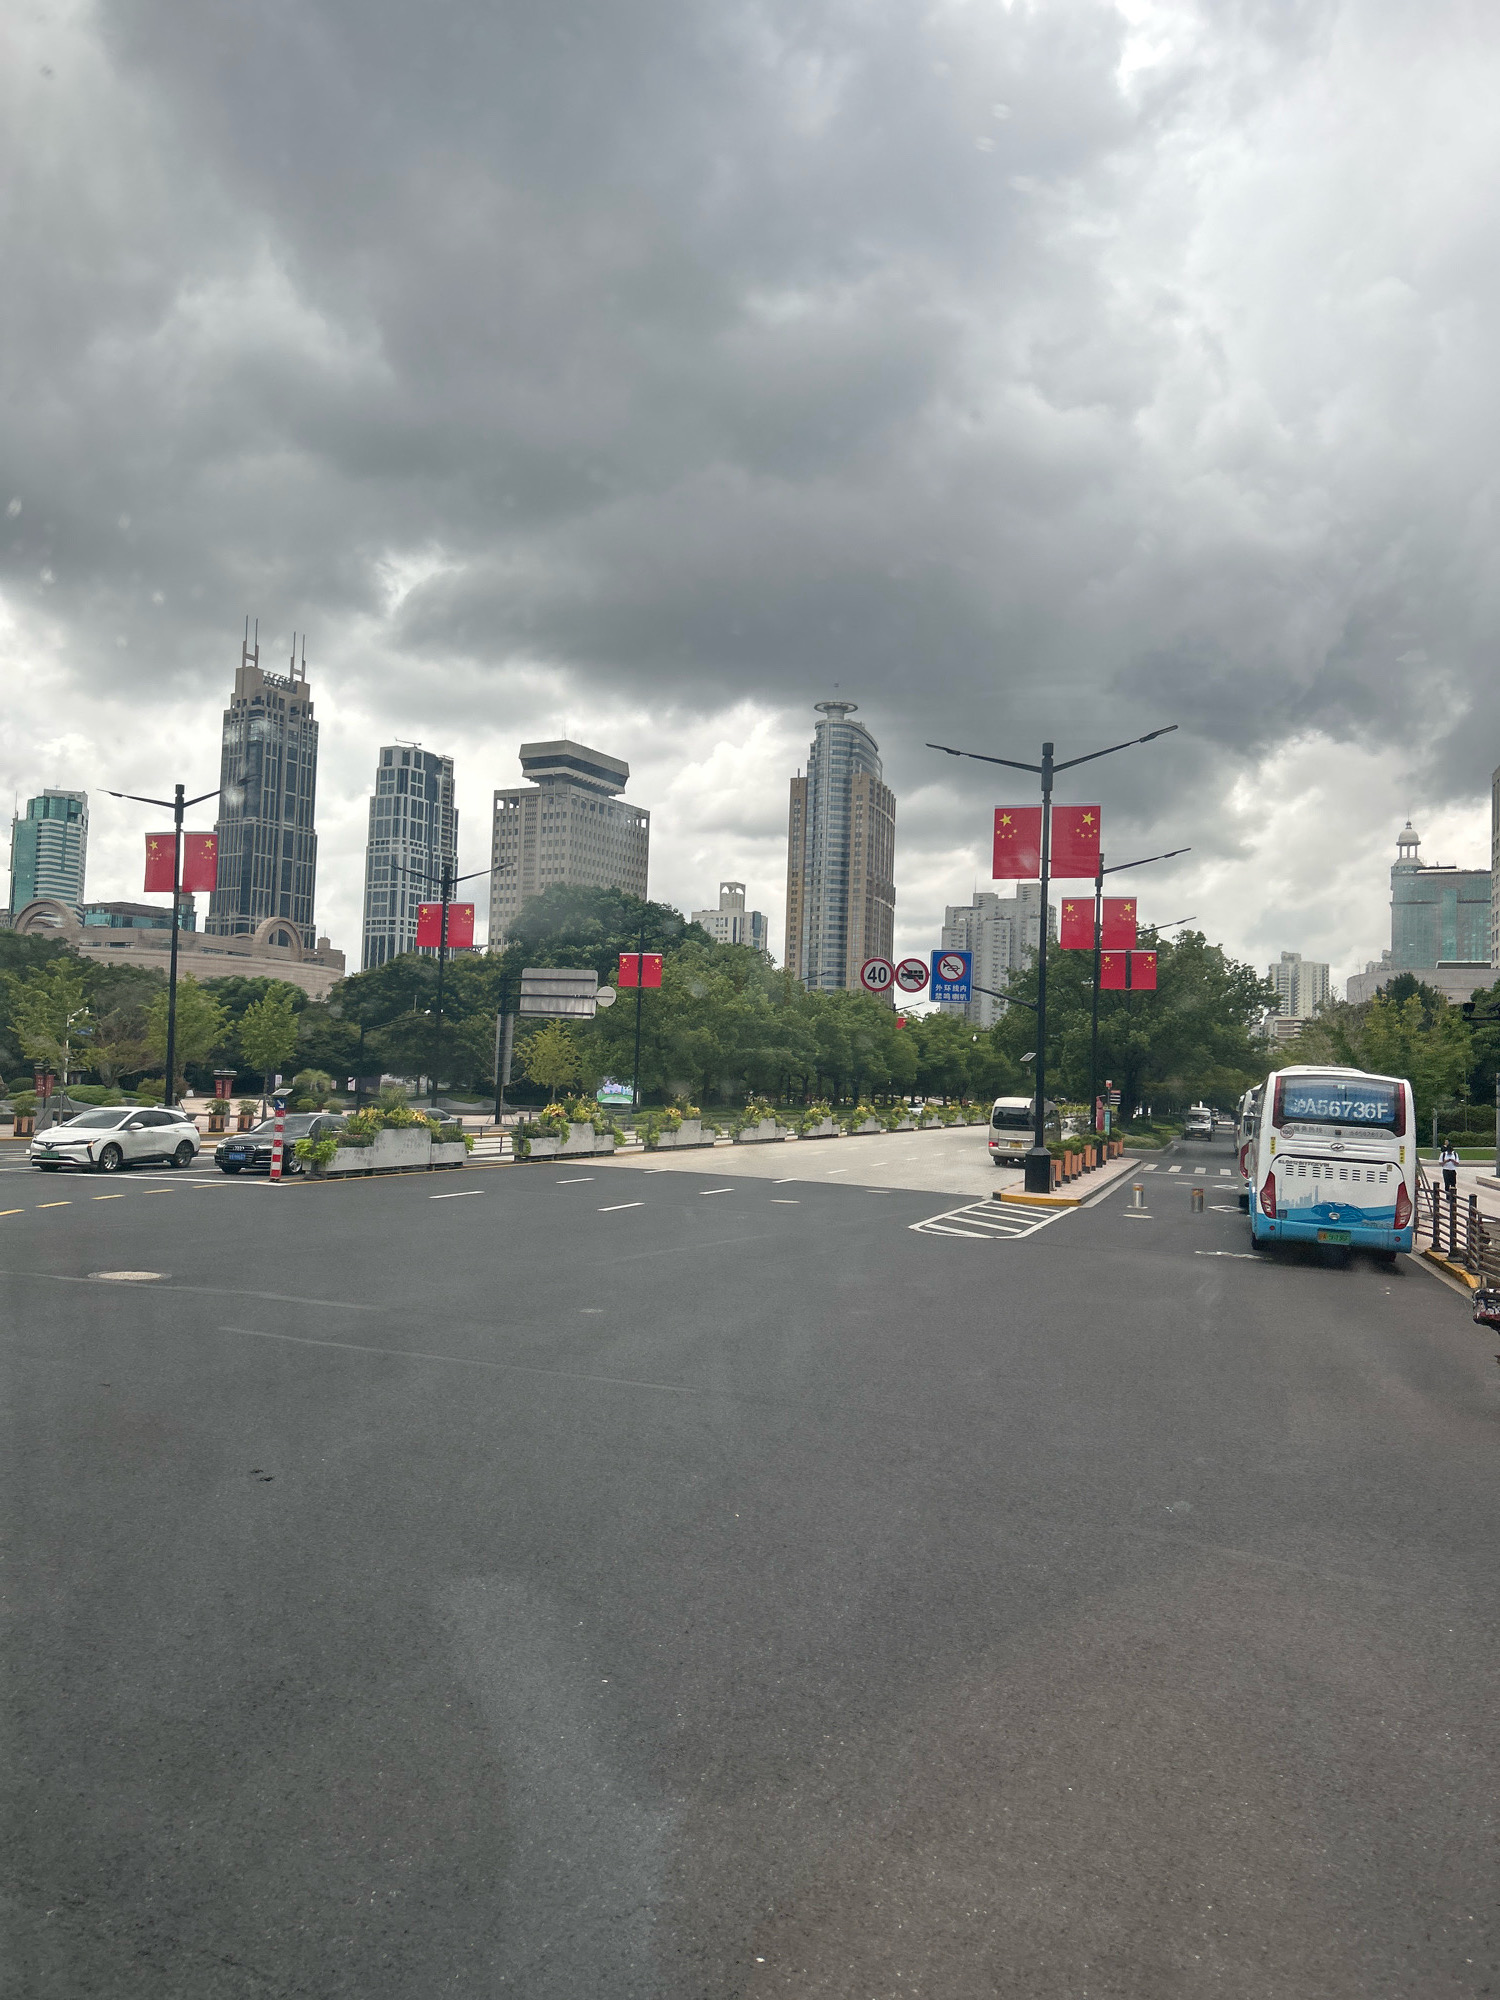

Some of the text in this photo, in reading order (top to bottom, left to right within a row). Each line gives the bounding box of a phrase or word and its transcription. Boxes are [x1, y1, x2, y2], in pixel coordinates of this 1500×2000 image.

[867, 967, 887, 983] 40
[935, 984, 967, 992] 外环线内
[935, 993, 968, 1001] 禁鸣喇叭
[1292, 1098, 1389, 1119] 沪A56736F
